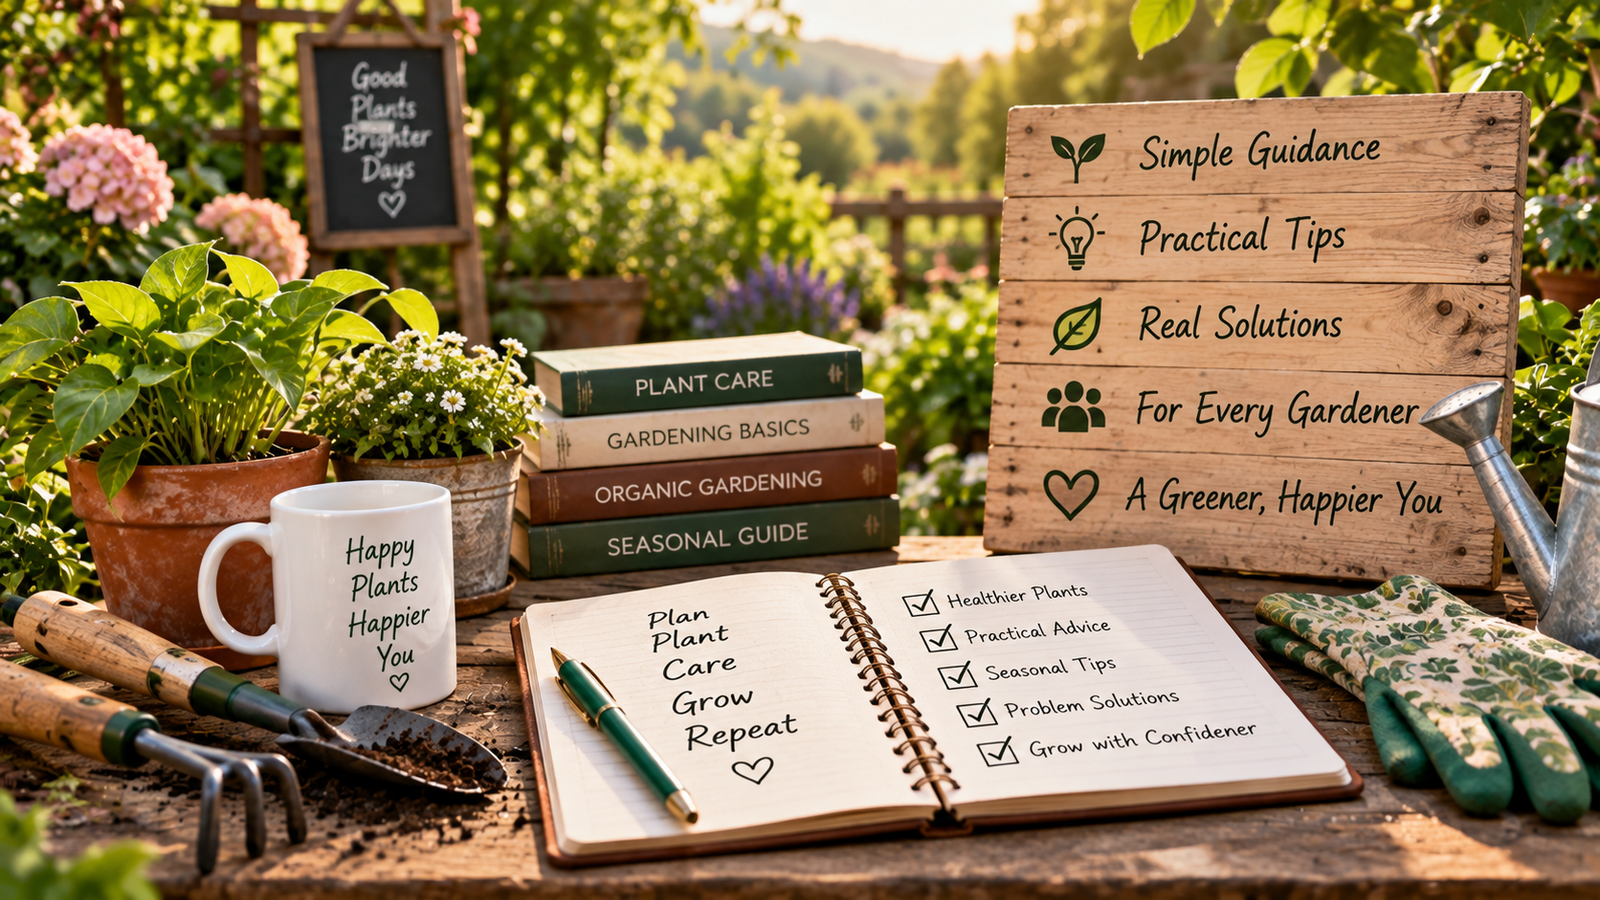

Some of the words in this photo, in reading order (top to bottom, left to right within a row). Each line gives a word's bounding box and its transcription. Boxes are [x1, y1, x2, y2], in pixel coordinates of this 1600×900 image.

[352, 60, 409, 92] Good
[351, 93, 417, 122] Plants
[1139, 132, 1233, 181] Simple
[1247, 128, 1381, 170] Guidance
[361, 155, 415, 189] Days
[1139, 216, 1269, 256] Practical
[1285, 216, 1346, 263] Tips
[1139, 305, 1201, 341] Real
[1214, 304, 1343, 340] Solutions
[635, 374, 708, 397] PLANT
[714, 369, 774, 391] CARE
[1136, 390, 1182, 424] For
[1196, 390, 1274, 438] Every
[1287, 390, 1420, 426] Gardener
[607, 424, 732, 449] GARDENING
[739, 418, 810, 440] BASICS
[595, 480, 692, 504] ORGANIC
[698, 469, 823, 496] GARDENING
[1125, 476, 1147, 512] A
[1159, 477, 1266, 516] Greener,
[1278, 479, 1383, 526] Happier
[1395, 481, 1443, 516] You
[346, 535, 415, 569] Happy
[607, 529, 731, 556] SEASONAL
[738, 522, 809, 546] GUIDE
[351, 571, 419, 602] Plants
[946, 587, 1026, 609] Healthier
[1030, 584, 1089, 601] Plants
[348, 606, 431, 642] Happier
[647, 608, 710, 630] Plan
[964, 623, 1047, 645] Practical
[1052, 619, 1112, 637] Advice
[651, 625, 729, 653] Plant
[376, 643, 415, 672] You
[662, 657, 737, 681] Care
[985, 658, 1069, 681] Seasonal
[1071, 656, 1117, 675] Tips
[672, 690, 754, 716] Grow
[1004, 699, 1085, 719] Problem
[1089, 691, 1180, 711] Solutions
[684, 713, 798, 753] Repeat
[1029, 740, 1083, 759] Grow
[1092, 732, 1139, 750] with
[1144, 723, 1257, 746] Confidener
